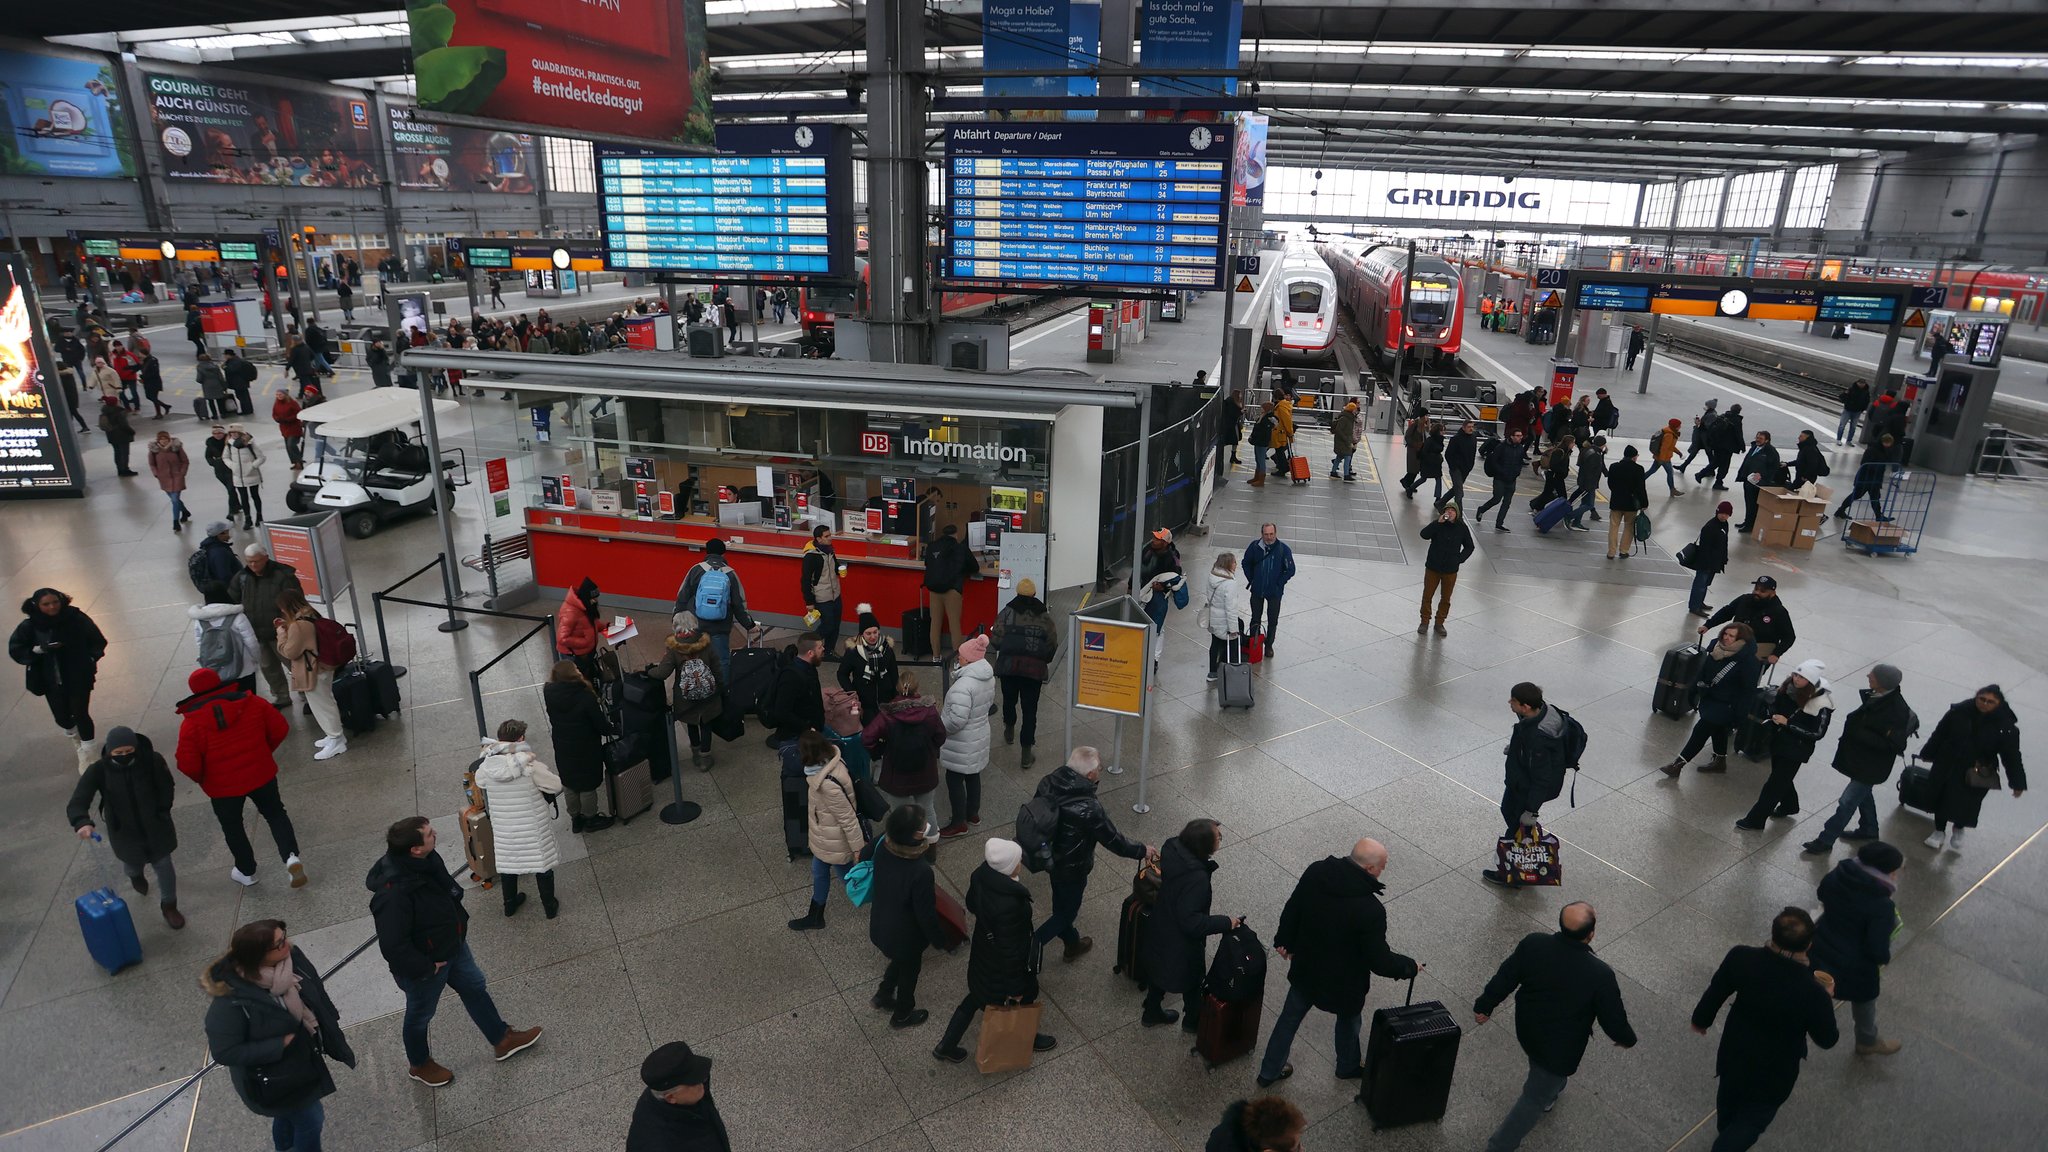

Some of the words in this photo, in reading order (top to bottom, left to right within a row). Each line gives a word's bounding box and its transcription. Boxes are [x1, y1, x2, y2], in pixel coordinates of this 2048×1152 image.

[1149, 1, 1160, 11] Iss
[1161, 0, 1183, 11] doch
[1184, 2, 1200, 11] mal
[989, 6, 1016, 17] Mogst
[1025, 6, 1055, 16] Hoibe?
[1149, 15, 1168, 26] gute
[1169, 14, 1197, 24] Sache.
[531, 58, 587, 80] QUADRATISCH.
[587, 70, 626, 87] PRAKTISCH.
[626, 80, 641, 90] GUT.
[151, 79, 215, 97] GOURMET
[217, 87, 249, 101] GEHT
[532, 75, 643, 115] #entdeckedasgut
[155, 95, 193, 110] AUCH
[195, 98, 252, 116] GÜNSTIG.
[406, 121, 438, 133] KLEINEN
[394, 132, 425, 144] GROSSE
[425, 135, 452, 145] AUGEN.
[953, 129, 991, 140] Abfahrt
[994, 131, 1032, 141] Departure
[1038, 132, 1062, 141] Départ
[712, 158, 738, 166] Frankfurt
[1087, 160, 1148, 169] Freising/Flughafen
[1086, 169, 1111, 177] Passau
[1112, 169, 1125, 177] Hbf
[1086, 181, 1117, 189] Frankfurt
[955, 187, 972, 195] 12:30
[1086, 190, 1125, 198] Bayrischzell
[1157, 191, 1167, 199] 34
[1386, 188, 1541, 210] GRUNDIG
[1085, 202, 1124, 211] Garmisch-P.
[1100, 211, 1112, 219] Hbf
[955, 220, 972, 228] 12:37
[1084, 223, 1137, 232] Hamburg-Altona
[266, 234, 279, 246] 15
[1111, 232, 1123, 240] Hbf
[447, 239, 459, 250] 16
[955, 240, 972, 248] 12:39
[1083, 243, 1109, 251] Buchloe
[1155, 246, 1164, 254] 28
[1083, 251, 1102, 259] Berlin
[1104, 252, 1117, 260] Hbf
[1155, 254, 1164, 262] 17
[1083, 264, 1095, 272] Hof
[1241, 256, 1257, 271] 19
[1083, 272, 1099, 280] Prag
[1539, 269, 1561, 285] 20
[1923, 287, 1946, 304] 21
[864, 435, 887, 451] DB
[903, 435, 1027, 463] Information
[1509, 852, 1550, 864] FRISCHE
